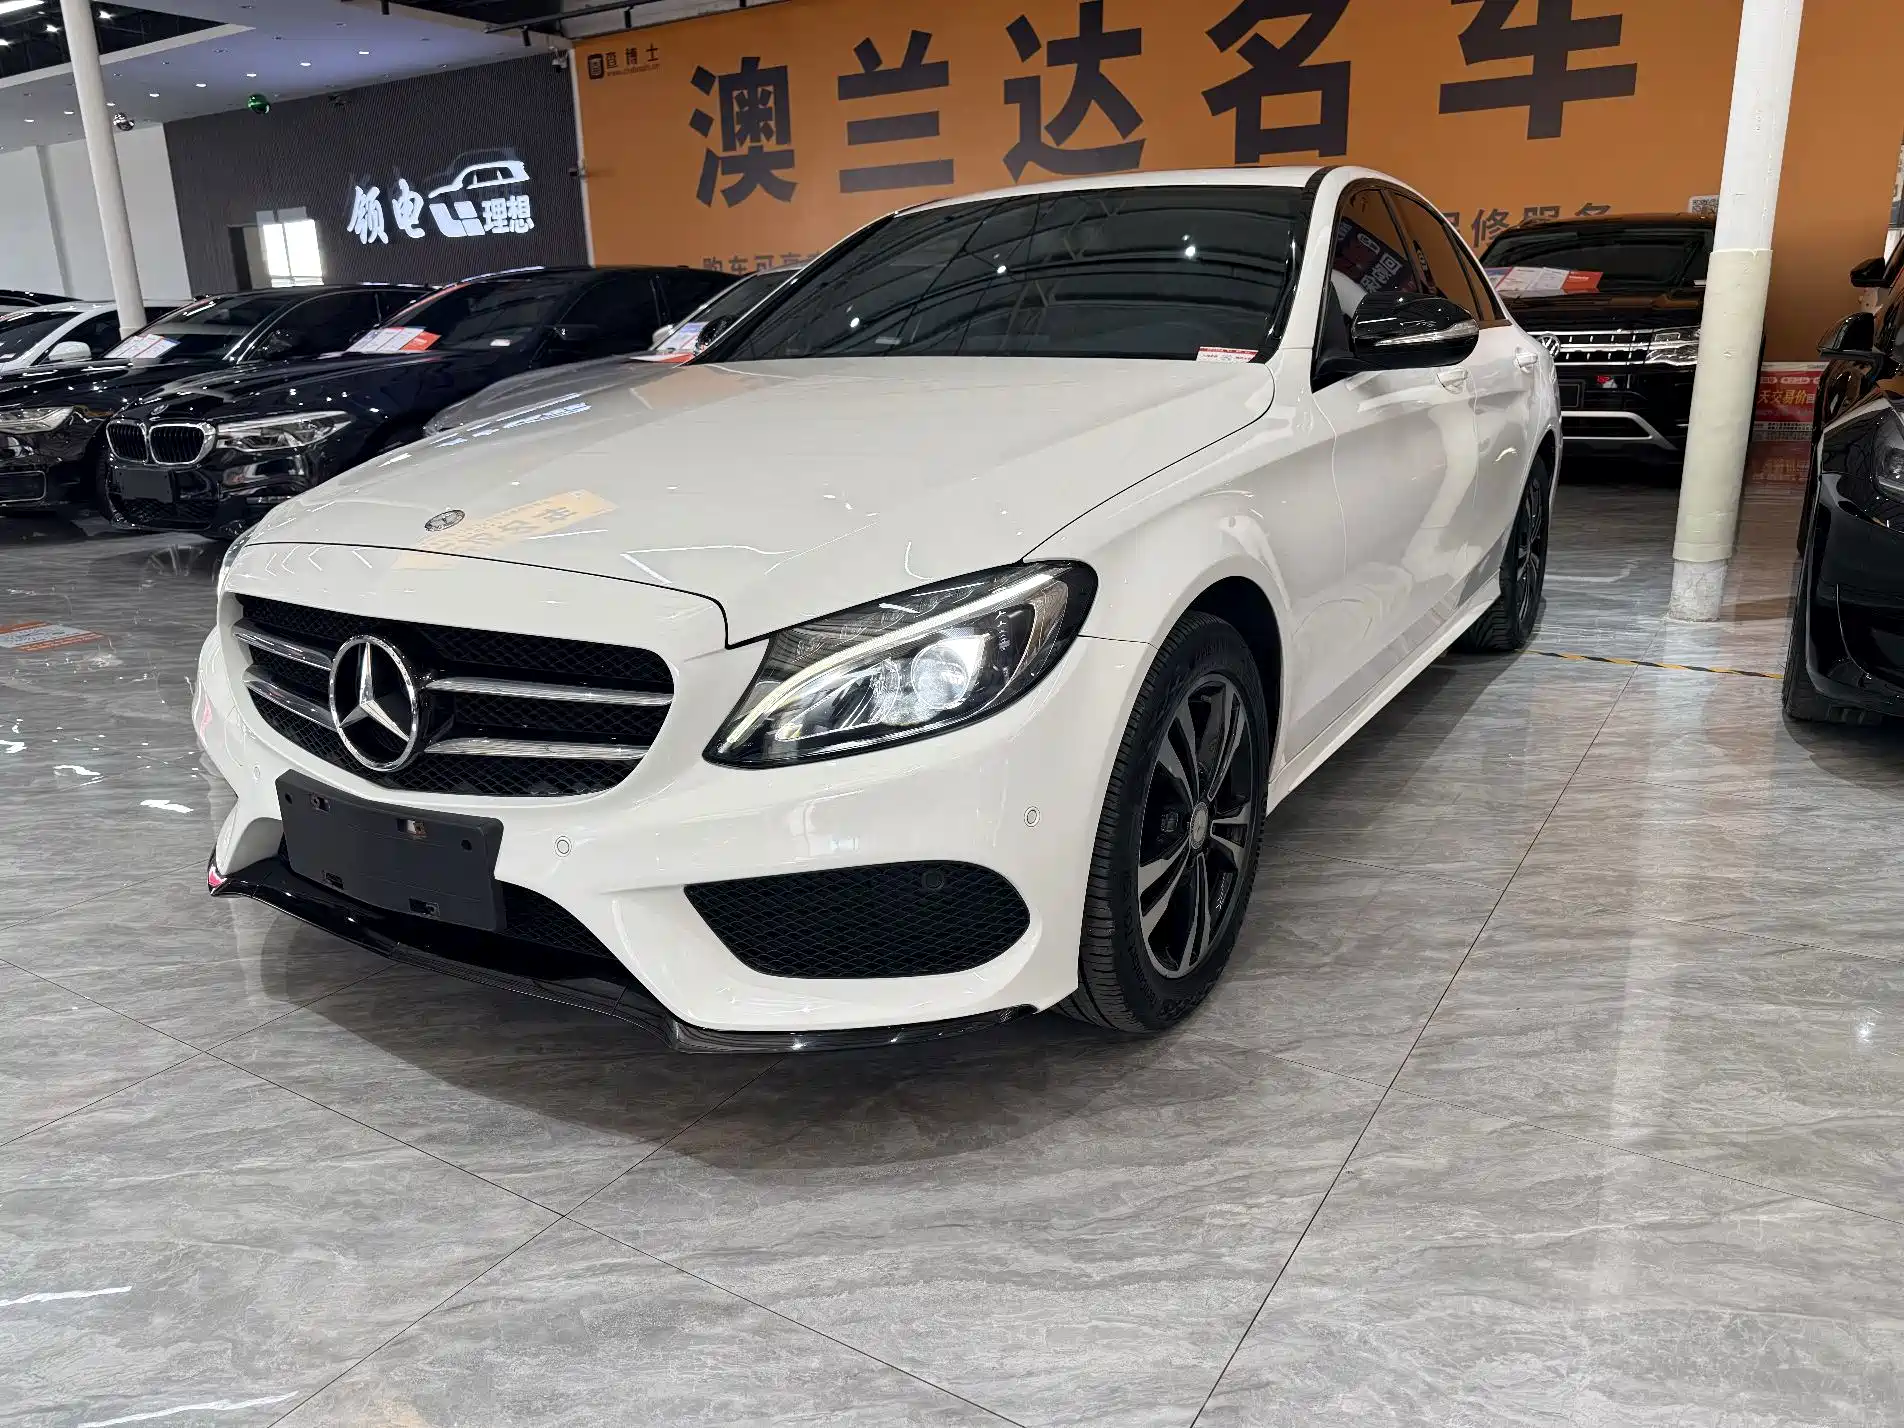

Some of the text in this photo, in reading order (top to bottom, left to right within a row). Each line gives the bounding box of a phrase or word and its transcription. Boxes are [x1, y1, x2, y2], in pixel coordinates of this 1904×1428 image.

[689, 0, 1637, 208] 澳兰达名车
[481, 195, 535, 234] 理想
